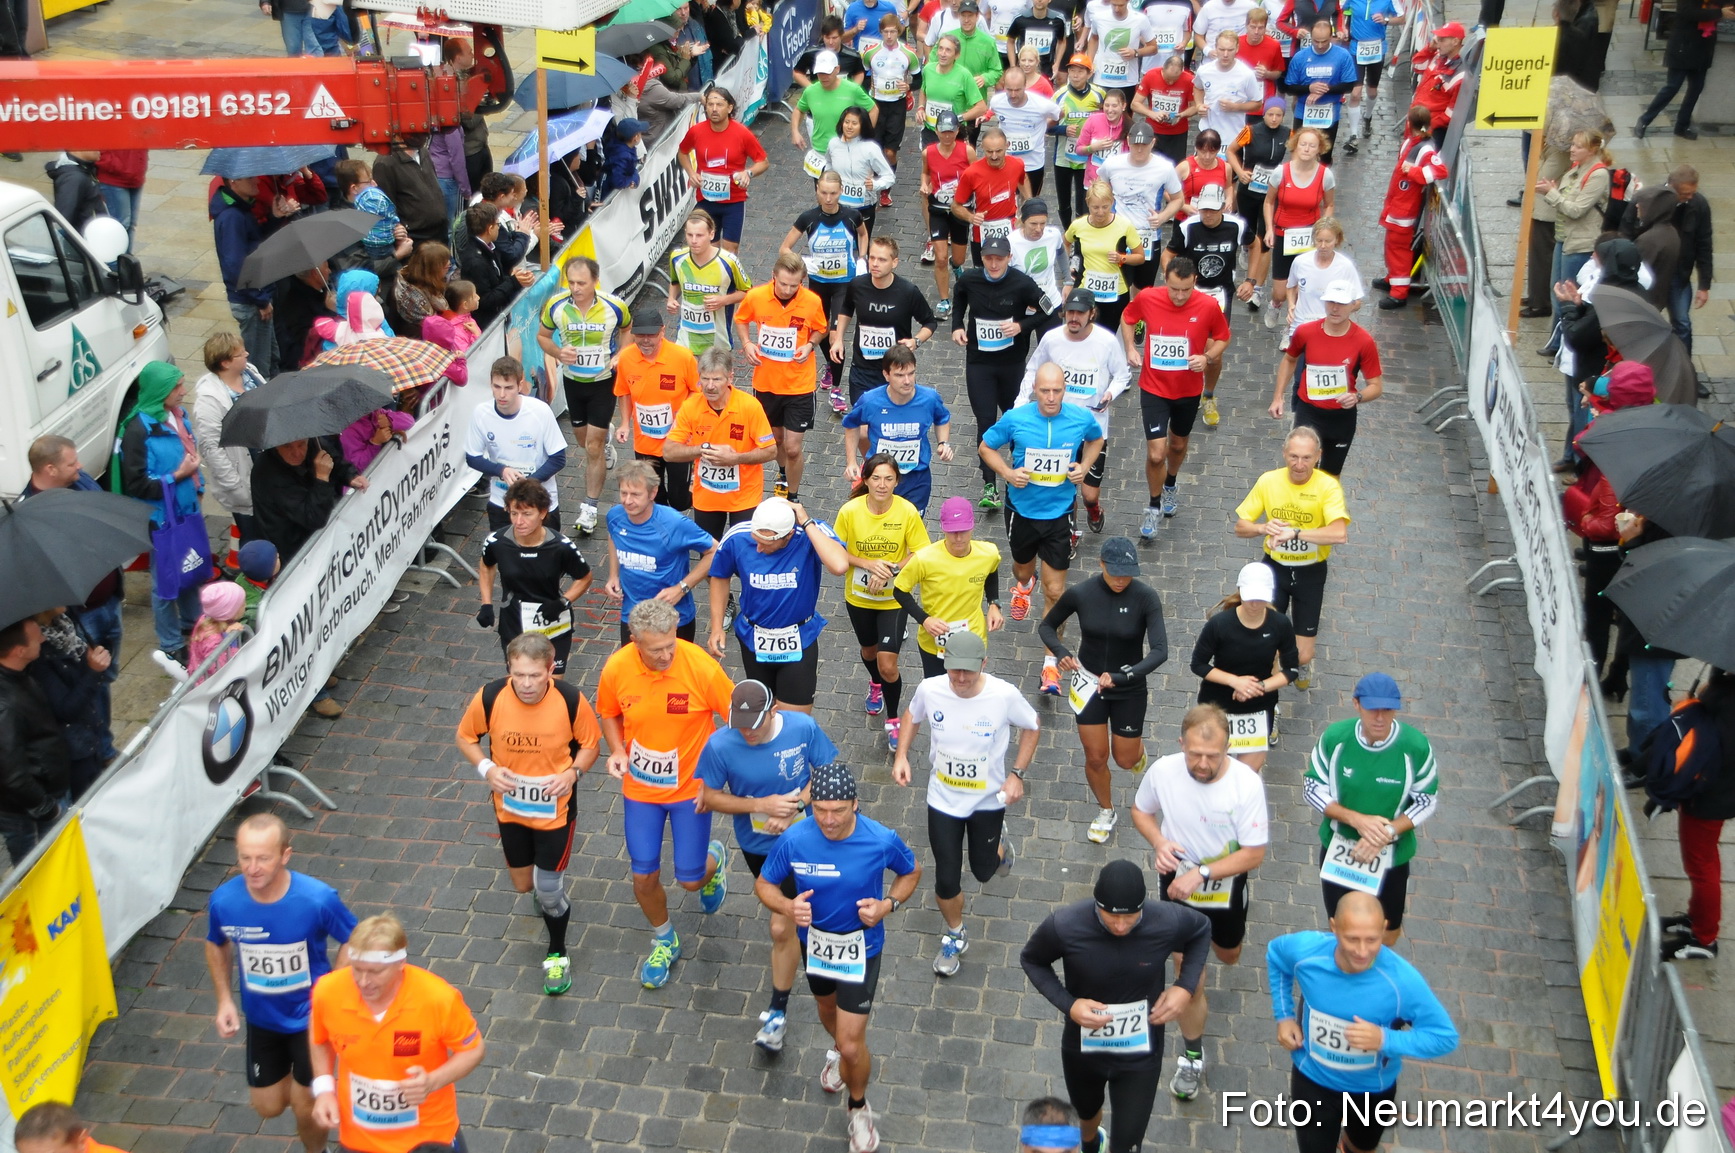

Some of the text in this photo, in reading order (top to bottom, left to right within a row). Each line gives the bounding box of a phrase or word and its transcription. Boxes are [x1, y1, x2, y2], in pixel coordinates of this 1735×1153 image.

[1360, 46, 1380, 56] 2579
[1103, 64, 1126, 75] 2749
[1485, 55, 1550, 74] Jugend-
[1500, 75, 1531, 90] lauf
[131, 95, 212, 120] 09181
[220, 92, 291, 116] 6352
[1154, 101, 1177, 112] 2533
[1307, 108, 1330, 119] 2767
[1007, 140, 1030, 151] 2598
[703, 180, 727, 192] 2287
[845, 186, 863, 197] 068
[819, 260, 841, 270] 126
[683, 283, 720, 293] BOCK
[1087, 278, 1116, 291] 2984
[869, 302, 888, 313] run
[683, 309, 711, 324] 3076
[568, 323, 606, 332] BOCK
[762, 333, 793, 349] 2735
[863, 334, 892, 348] 2480
[766, 349, 787, 358] Andreas
[1154, 344, 1185, 358] 2296
[577, 353, 600, 366] 077
[1064, 371, 1094, 386] 2401
[1315, 374, 1338, 387] 101
[1069, 386, 1086, 394] Marco
[638, 412, 669, 427] 2917
[881, 422, 920, 433] HUBER
[1034, 458, 1060, 472] 241
[701, 465, 736, 481] 2734
[375, 528, 402, 574] Mehr
[1280, 538, 1309, 552] 488
[617, 549, 657, 564] HUBER
[182, 557, 204, 574] adidas
[750, 572, 798, 584] HUBER
[262, 595, 314, 690] BMW
[757, 636, 798, 651] 2765
[1073, 672, 1089, 692] 67
[1229, 718, 1257, 735] 183
[506, 736, 541, 747] OEXL
[632, 751, 674, 774] 2704
[945, 762, 977, 778] 133
[943, 777, 978, 788] Alexander
[1332, 844, 1381, 873] 250
[1334, 867, 1368, 883] Reinhard
[812, 940, 860, 960] 2479
[249, 955, 302, 975] 2610
[3, 988, 62, 1055] Außenplatten
[8, 1023, 48, 1072] Palisaden
[1326, 1052, 1355, 1064] Stefan
[13, 1052, 42, 1087] Stufen
[356, 1087, 411, 1111] 2659
[366, 1113, 399, 1124] Konrad
